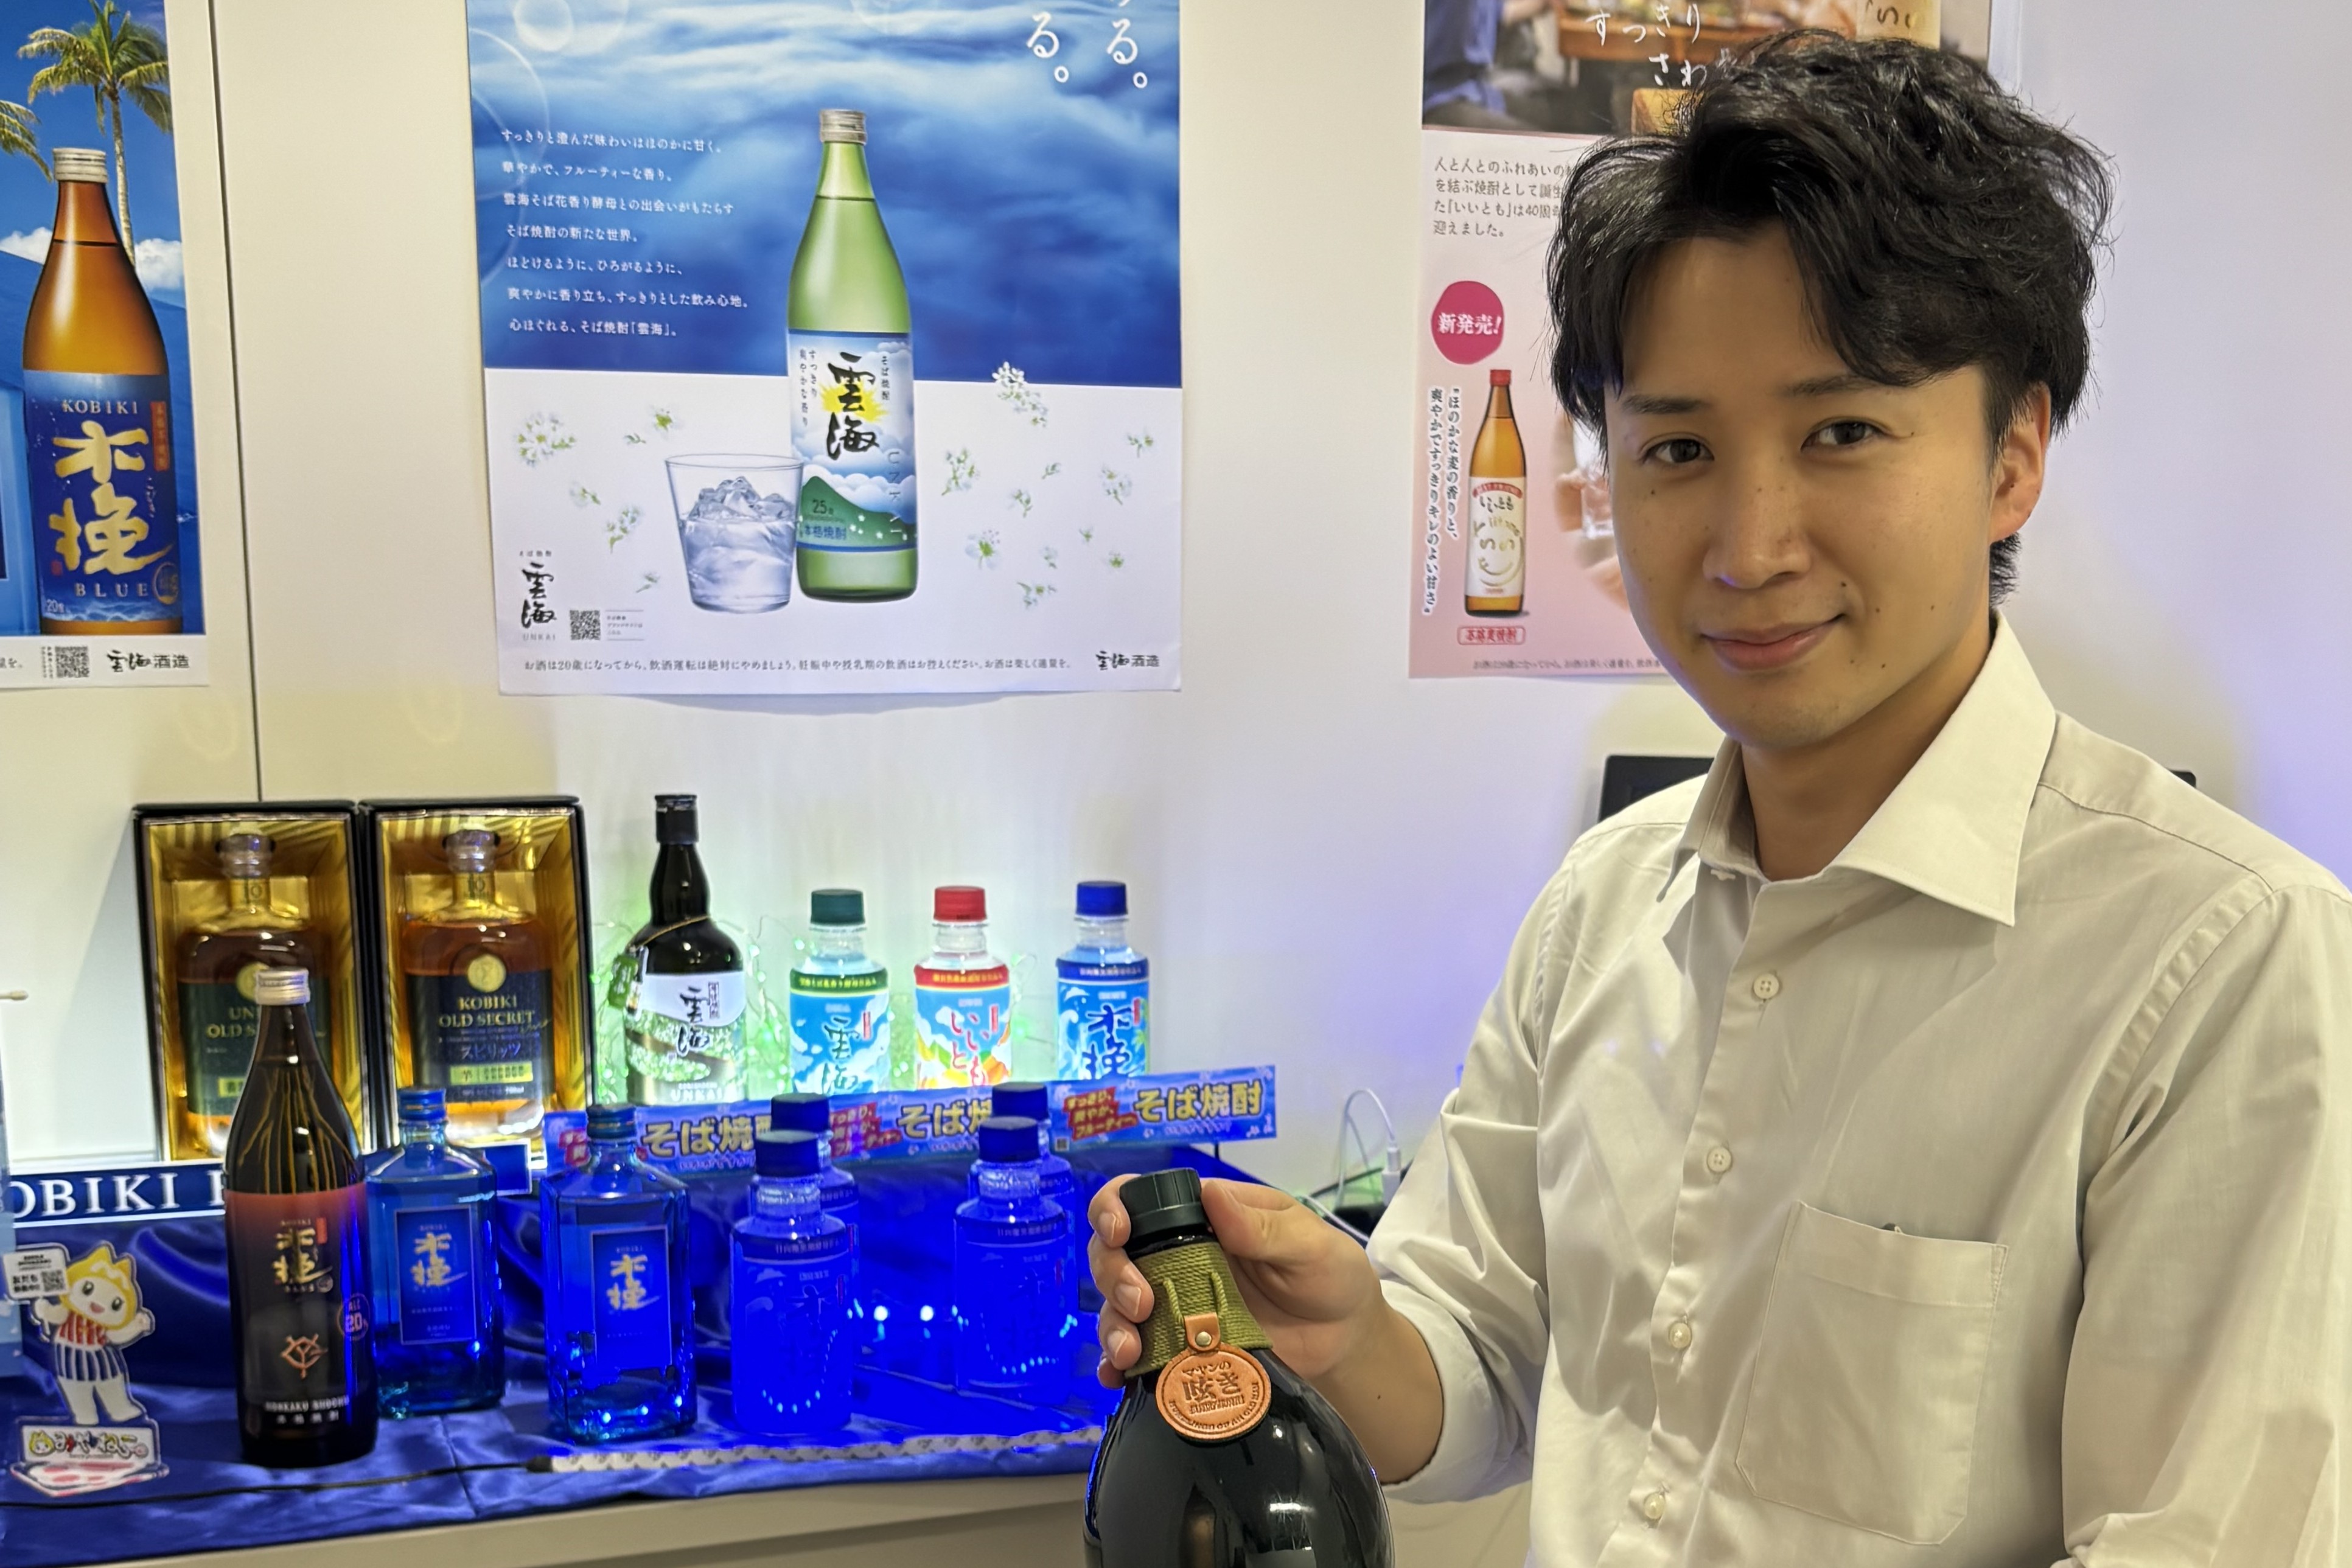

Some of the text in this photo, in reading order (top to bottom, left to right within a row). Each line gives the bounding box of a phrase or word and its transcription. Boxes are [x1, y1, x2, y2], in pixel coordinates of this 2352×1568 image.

[1586, 3, 1700, 47] すっきり
[1027, 12, 1069, 83] る。
[1106, 0, 1148, 88] る。
[501, 129, 722, 153] すっきりと澄んだ味わいはほのかに甘く。
[502, 161, 672, 181] 華やかで、フルーティーな香り。
[503, 192, 734, 215] 雲海そば花香り酵母との出会いがもたらす
[506, 225, 638, 243] そば焼酎の新たな世界。
[1433, 220, 1505, 238] 迎えました。
[508, 257, 683, 275] ほどけるように、ひろがるように、
[508, 288, 748, 308] 爽やかに香り立ち、すっきりとした飲み心地。
[509, 318, 677, 337] 心ほぐれる、そば焼酎「雲海」。
[1438, 312, 1502, 335] 新発売!
[62, 399, 138, 415] KOBIKI
[825, 350, 881, 462] 雲海
[48, 420, 175, 576] 木挽
[74, 582, 149, 599] BLUE
[521, 562, 557, 629] 雲海
[458, 994, 517, 1011] KOBIKI
[438, 1010, 535, 1028] OLD SECRET
[1136, 1079, 1262, 1123] そば焼酎
